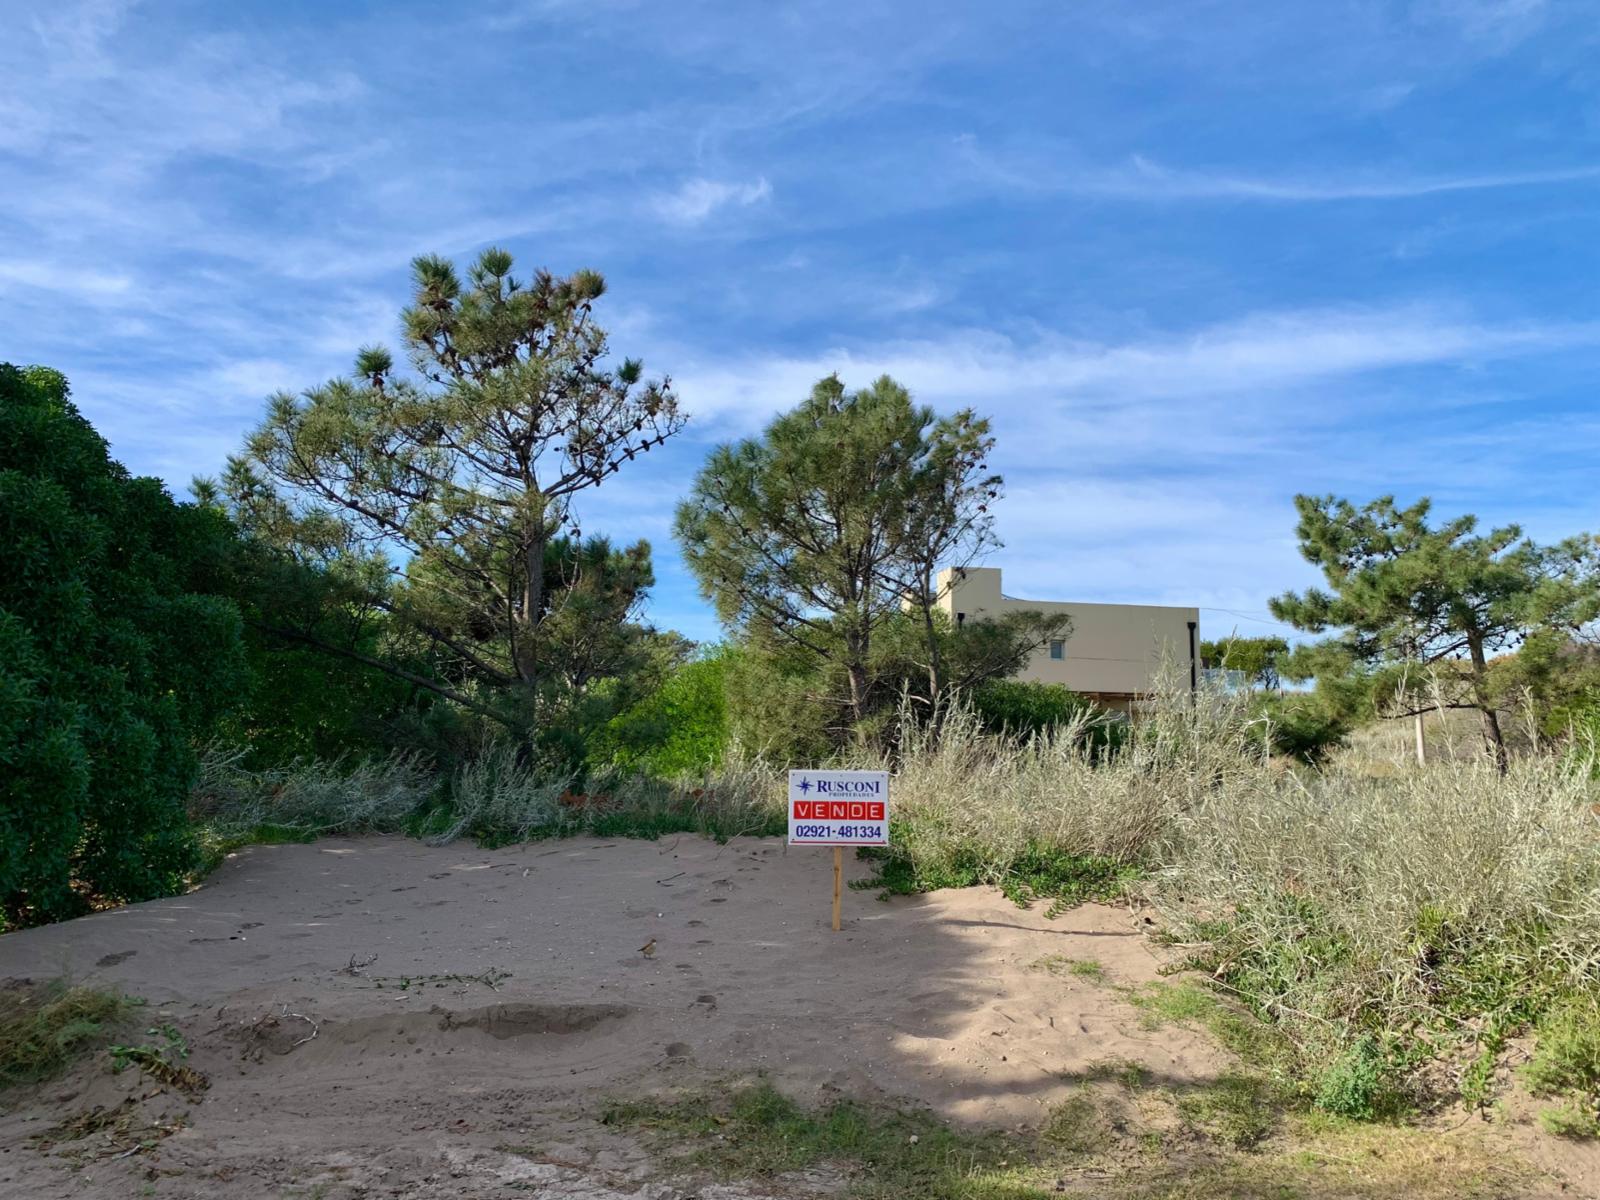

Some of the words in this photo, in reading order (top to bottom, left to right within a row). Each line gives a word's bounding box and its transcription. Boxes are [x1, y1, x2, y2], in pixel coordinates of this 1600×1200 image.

[816, 780, 880, 793] RUSCONI
[797, 804, 880, 818] VENDE
[796, 825, 882, 838] 02921-481334
